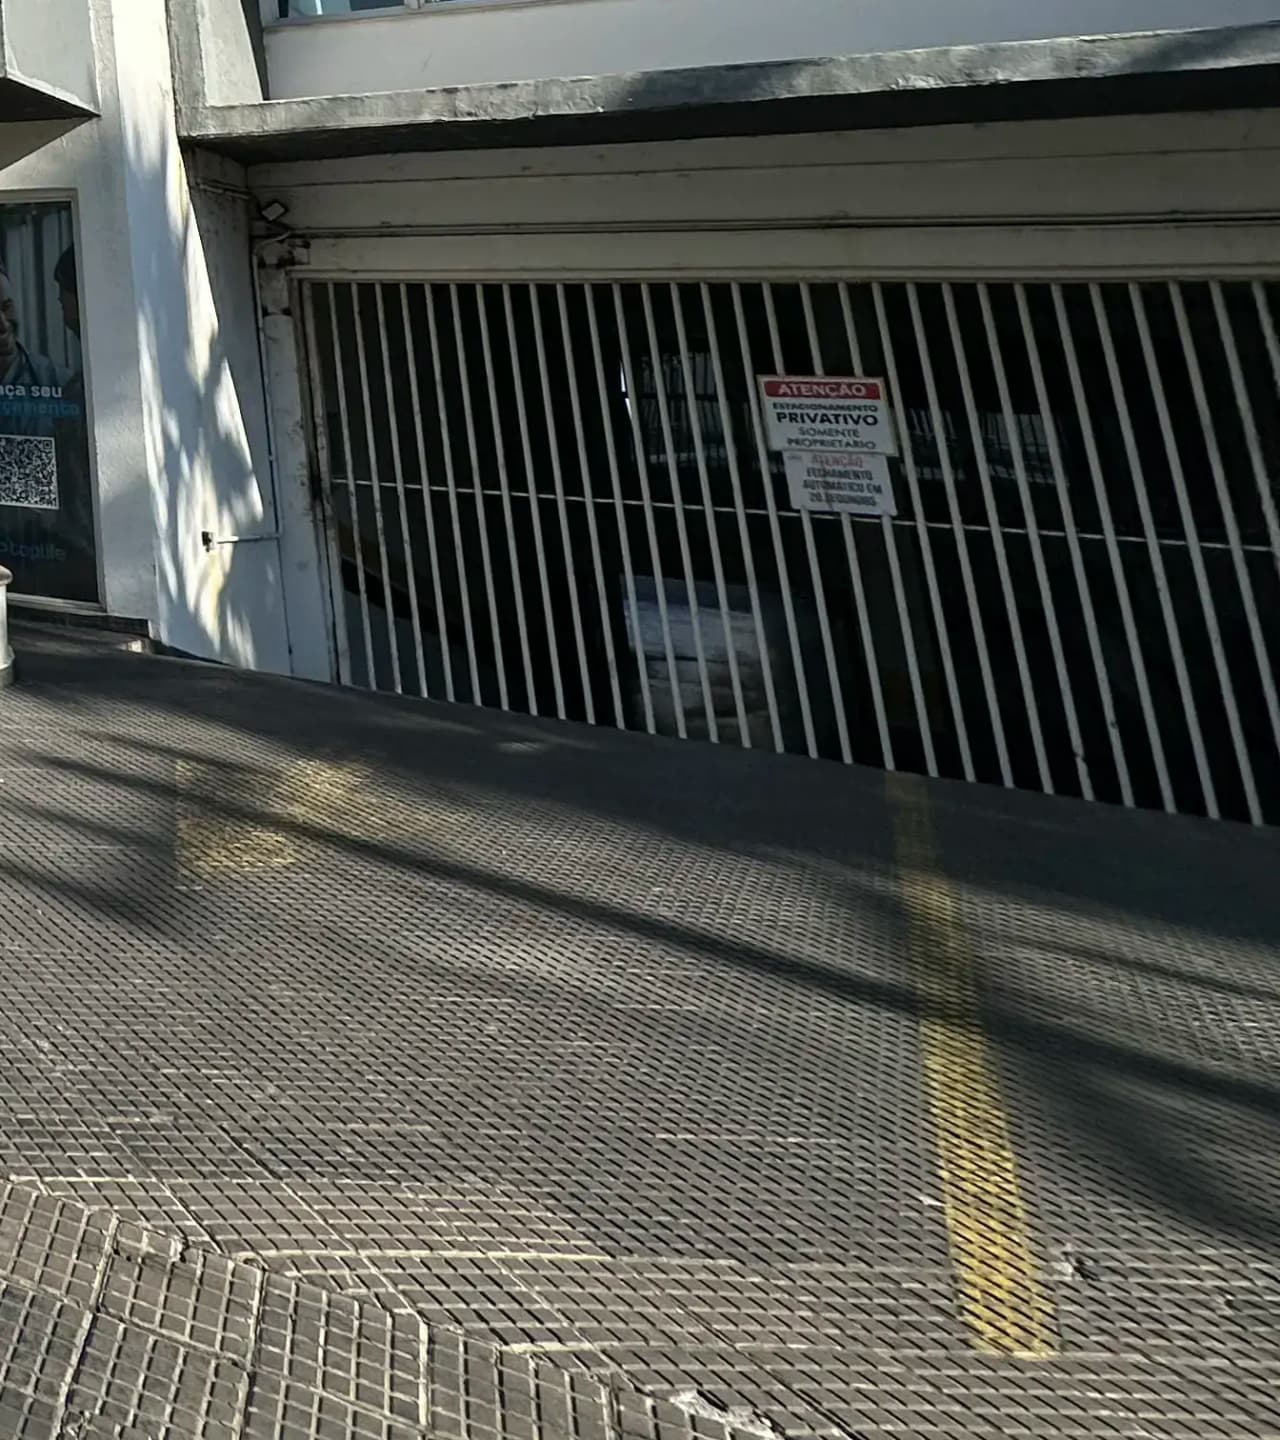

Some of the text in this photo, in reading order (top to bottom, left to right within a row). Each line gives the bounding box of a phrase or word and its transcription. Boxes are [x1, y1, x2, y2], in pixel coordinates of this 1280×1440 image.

[30, 385, 63, 398] seu
[779, 383, 866, 396] ATENÇÃO
[776, 412, 878, 426] PRIVATIVO
[798, 427, 861, 438] SOMENTE
